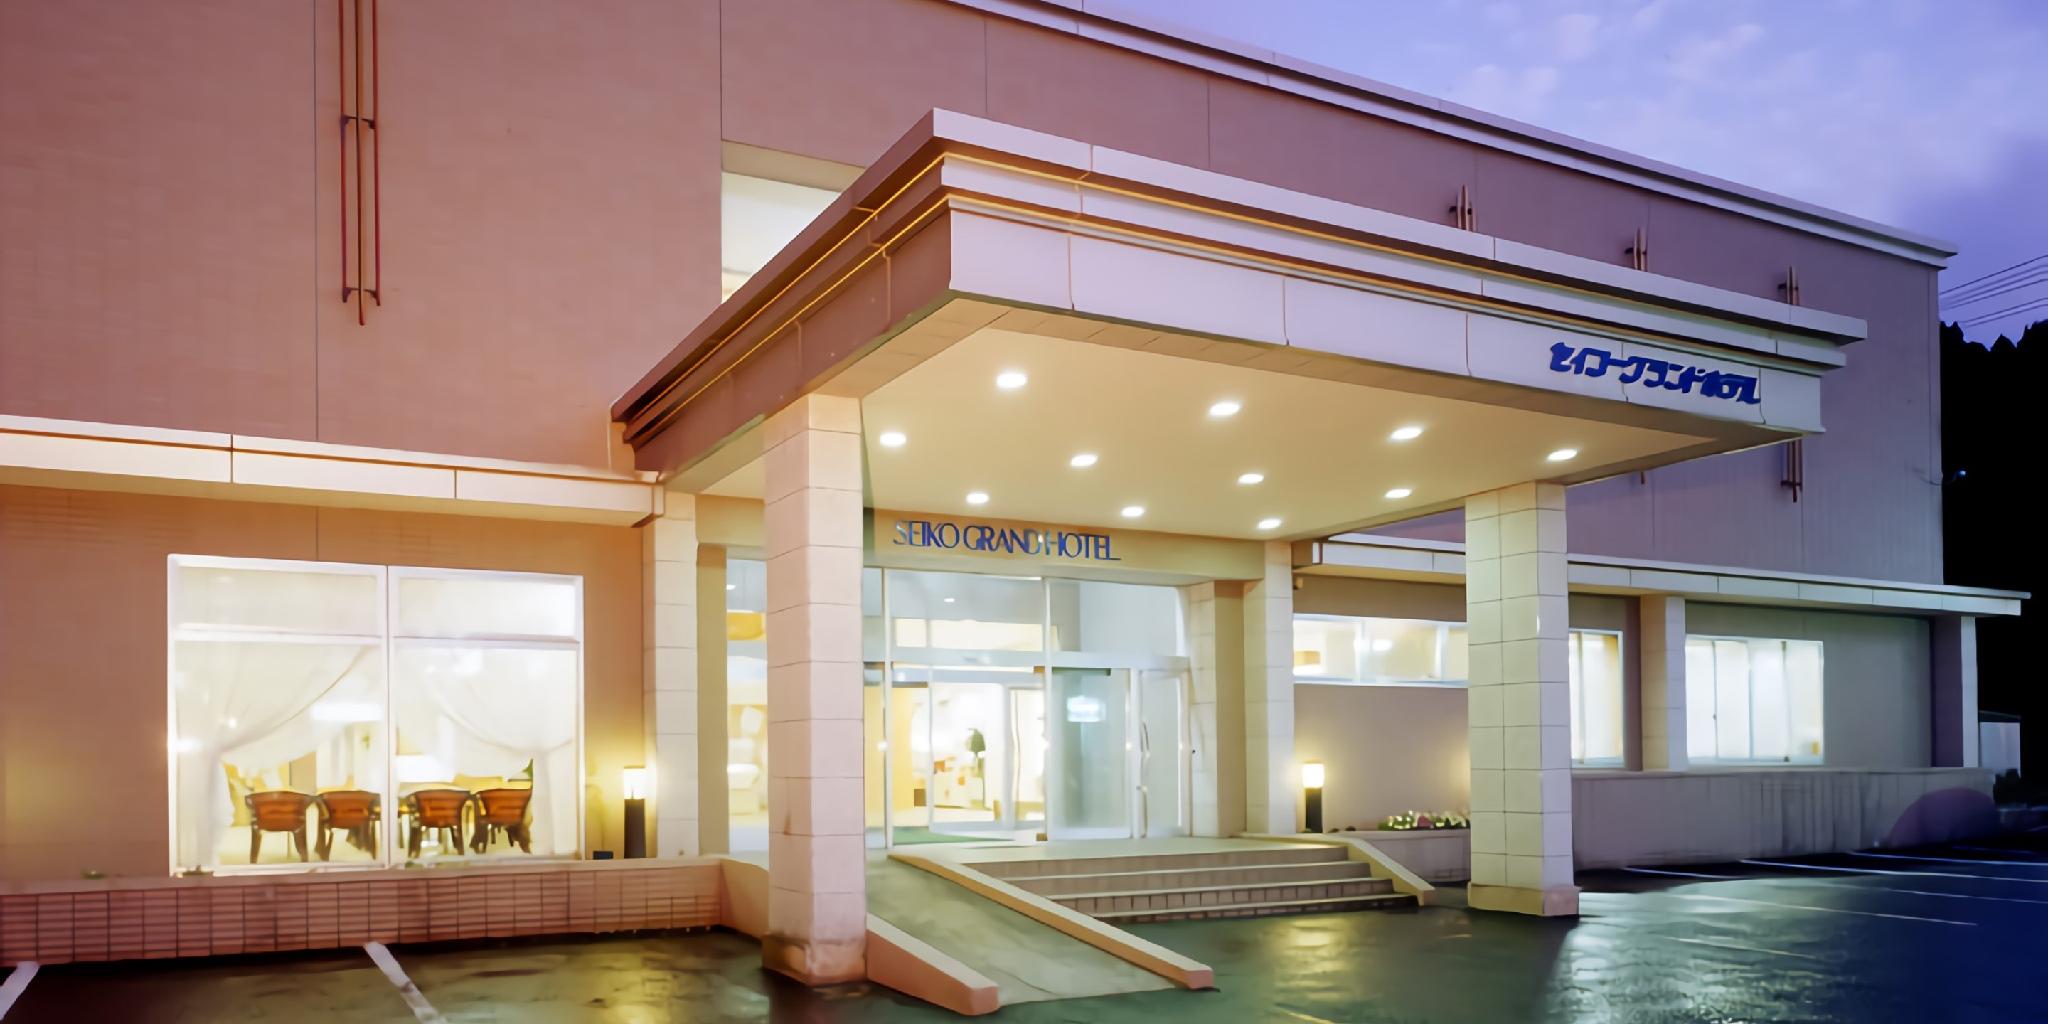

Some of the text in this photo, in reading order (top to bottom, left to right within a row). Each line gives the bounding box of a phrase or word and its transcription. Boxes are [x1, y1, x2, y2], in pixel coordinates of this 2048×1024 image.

[893, 520, 1121, 561] SEIKO GRAND HOTEL
